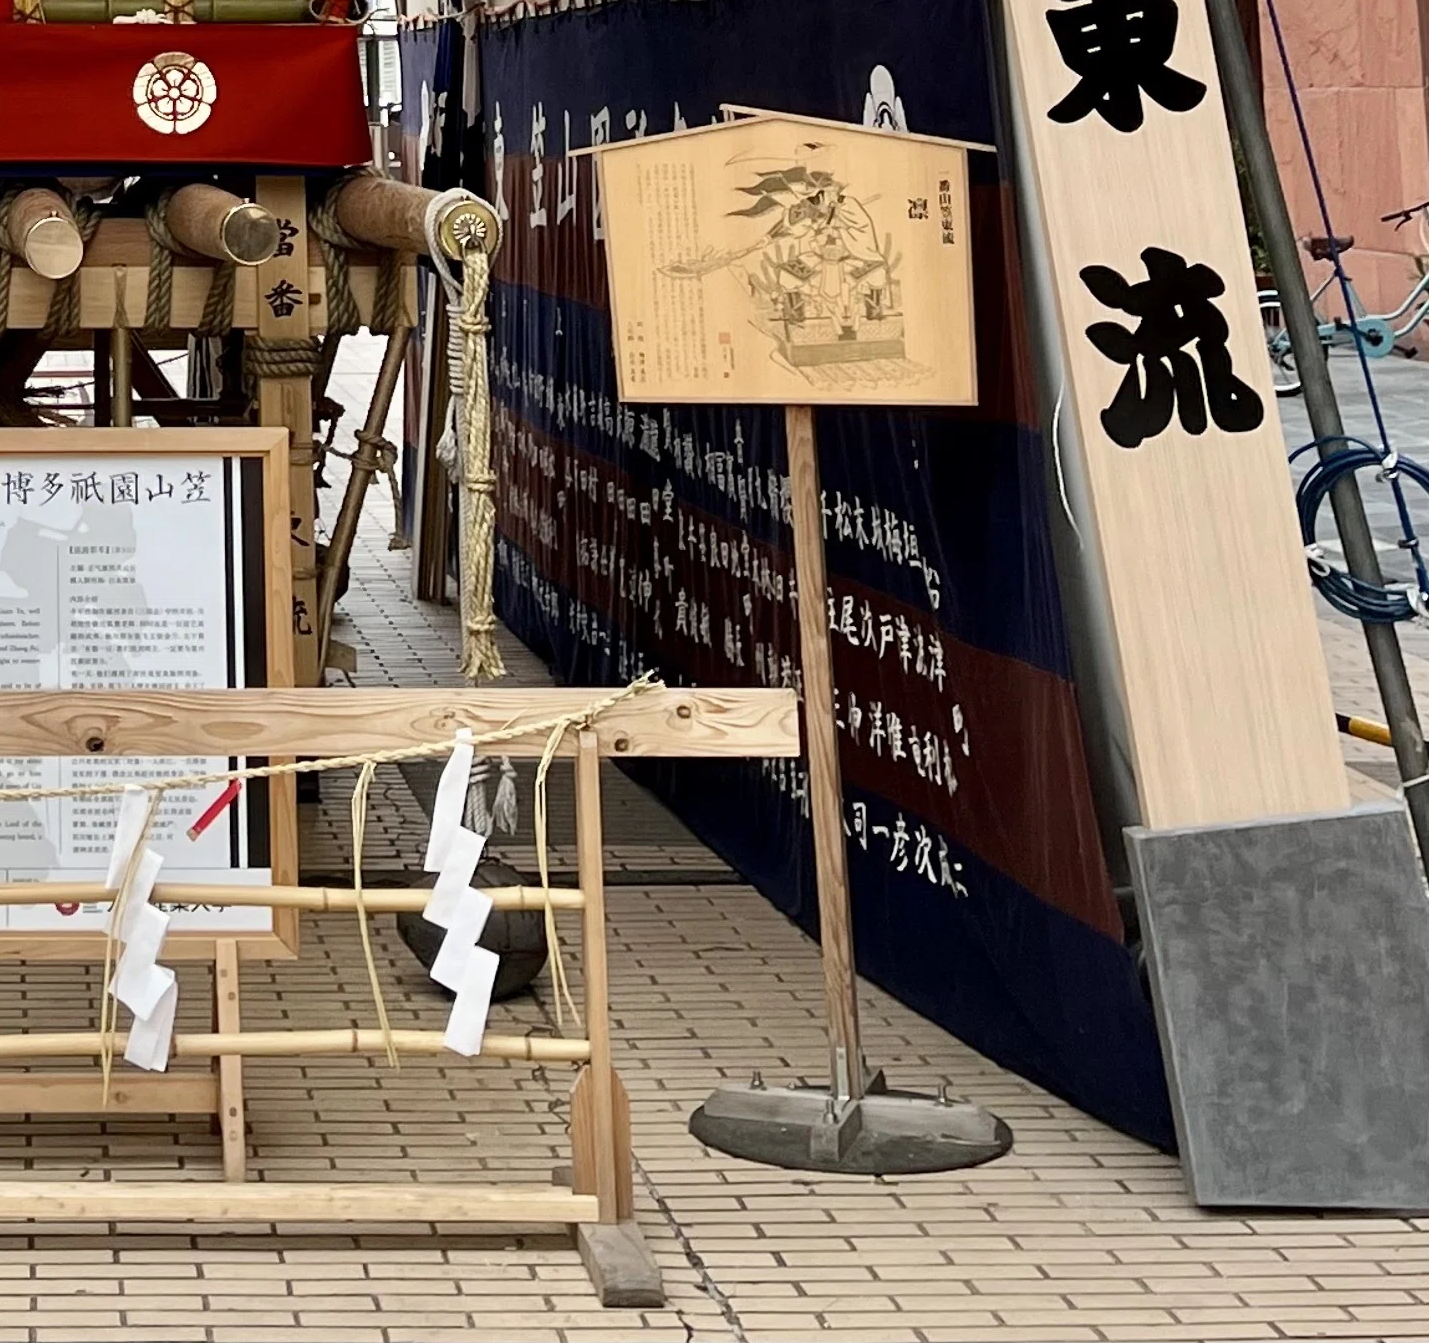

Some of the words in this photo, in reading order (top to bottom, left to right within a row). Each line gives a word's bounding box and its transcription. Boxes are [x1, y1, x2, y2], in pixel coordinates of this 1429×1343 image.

[1, 471, 212, 505] 博多祇園山笠
